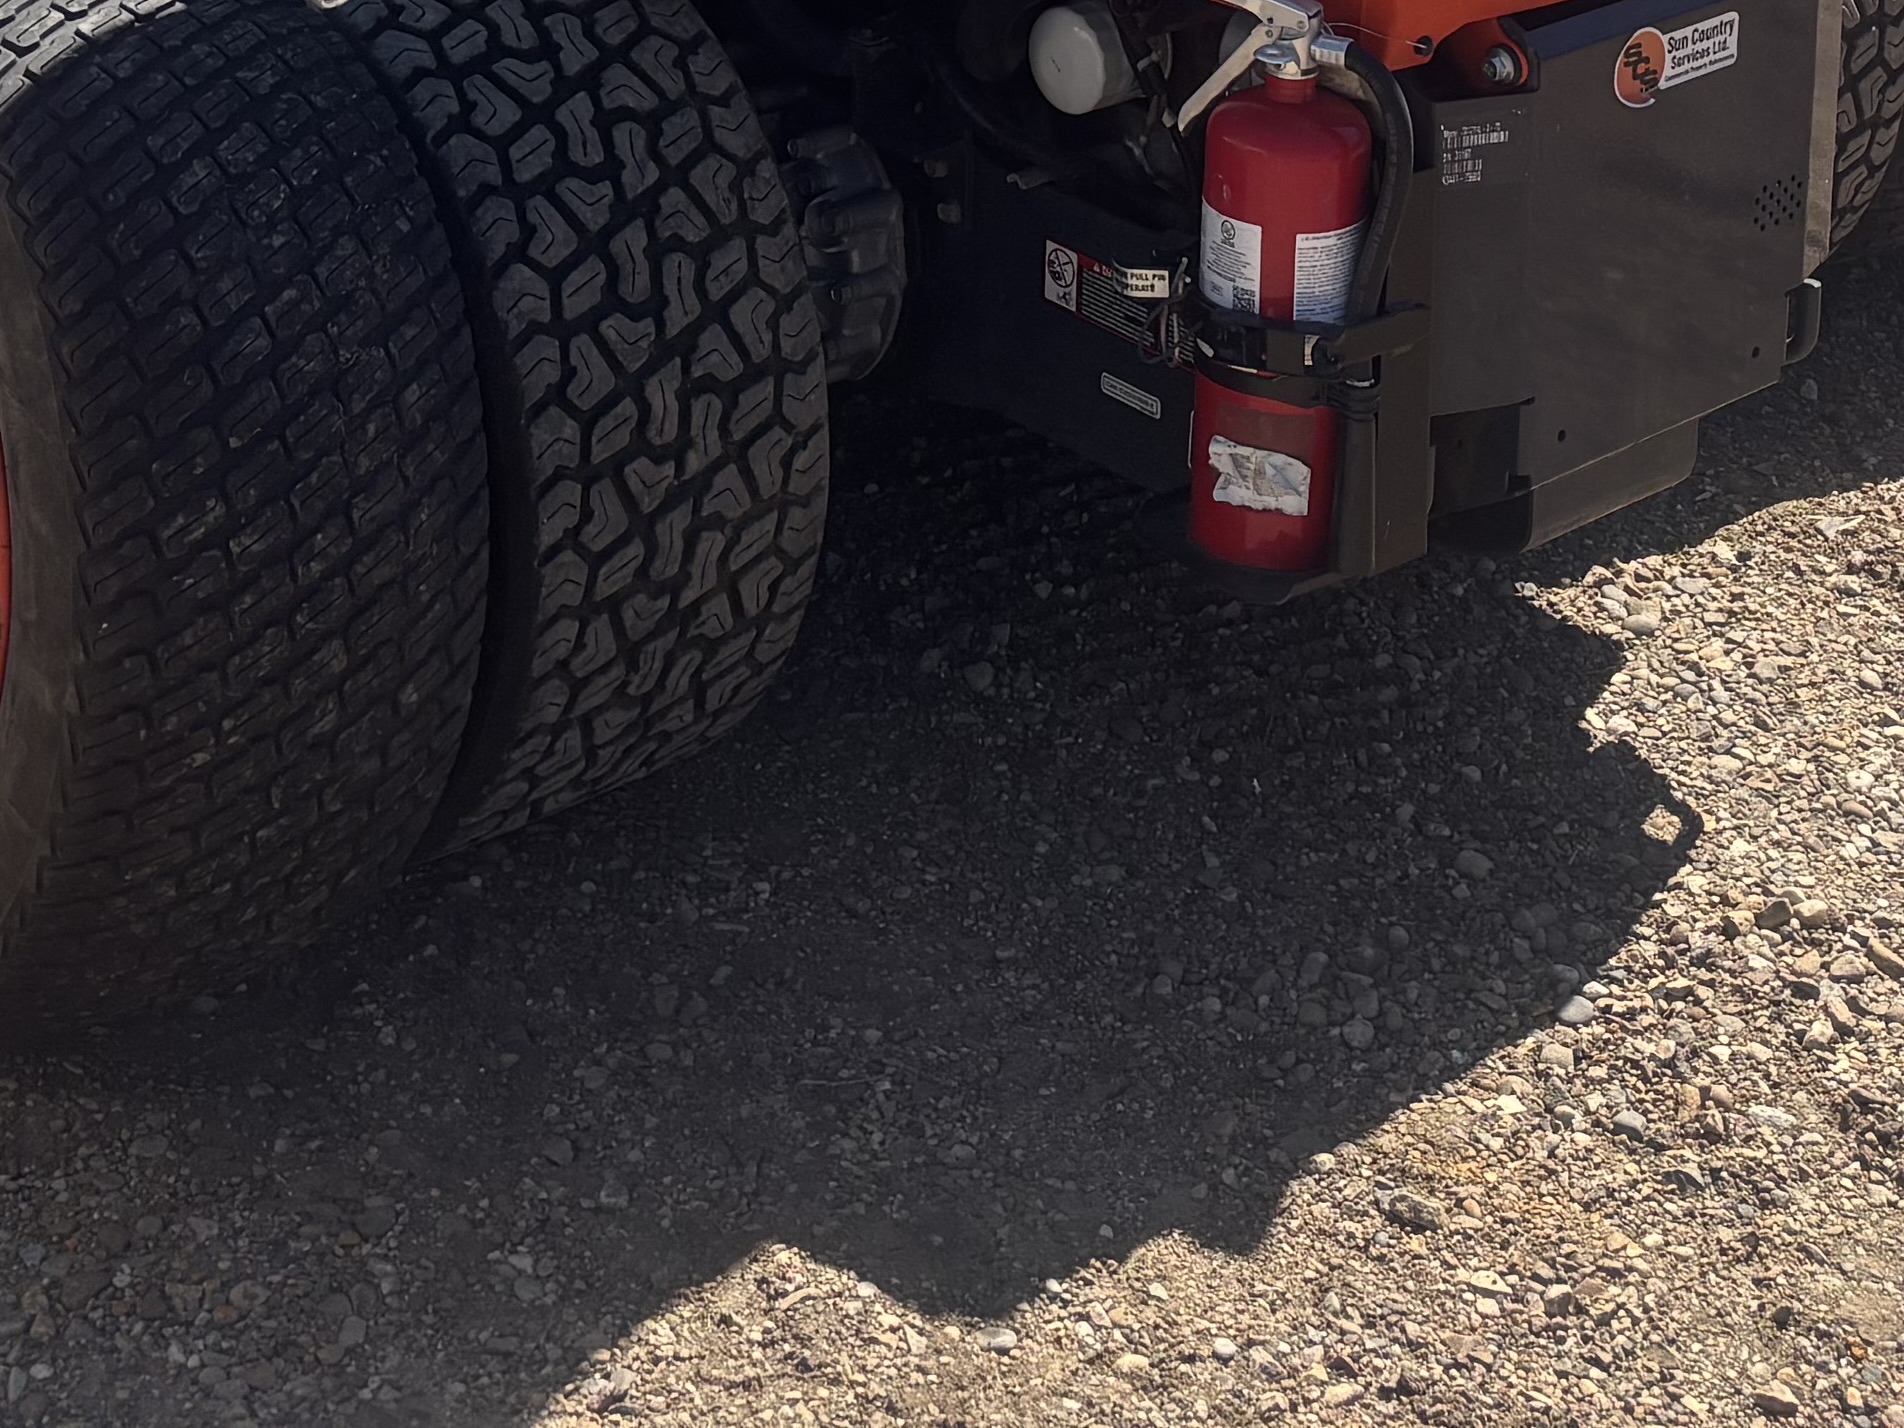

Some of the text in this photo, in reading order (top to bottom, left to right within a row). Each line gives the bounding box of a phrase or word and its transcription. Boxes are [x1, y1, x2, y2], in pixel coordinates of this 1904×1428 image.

[1667, 17, 1736, 55] Sun Country
[1670, 44, 1711, 70] Services
